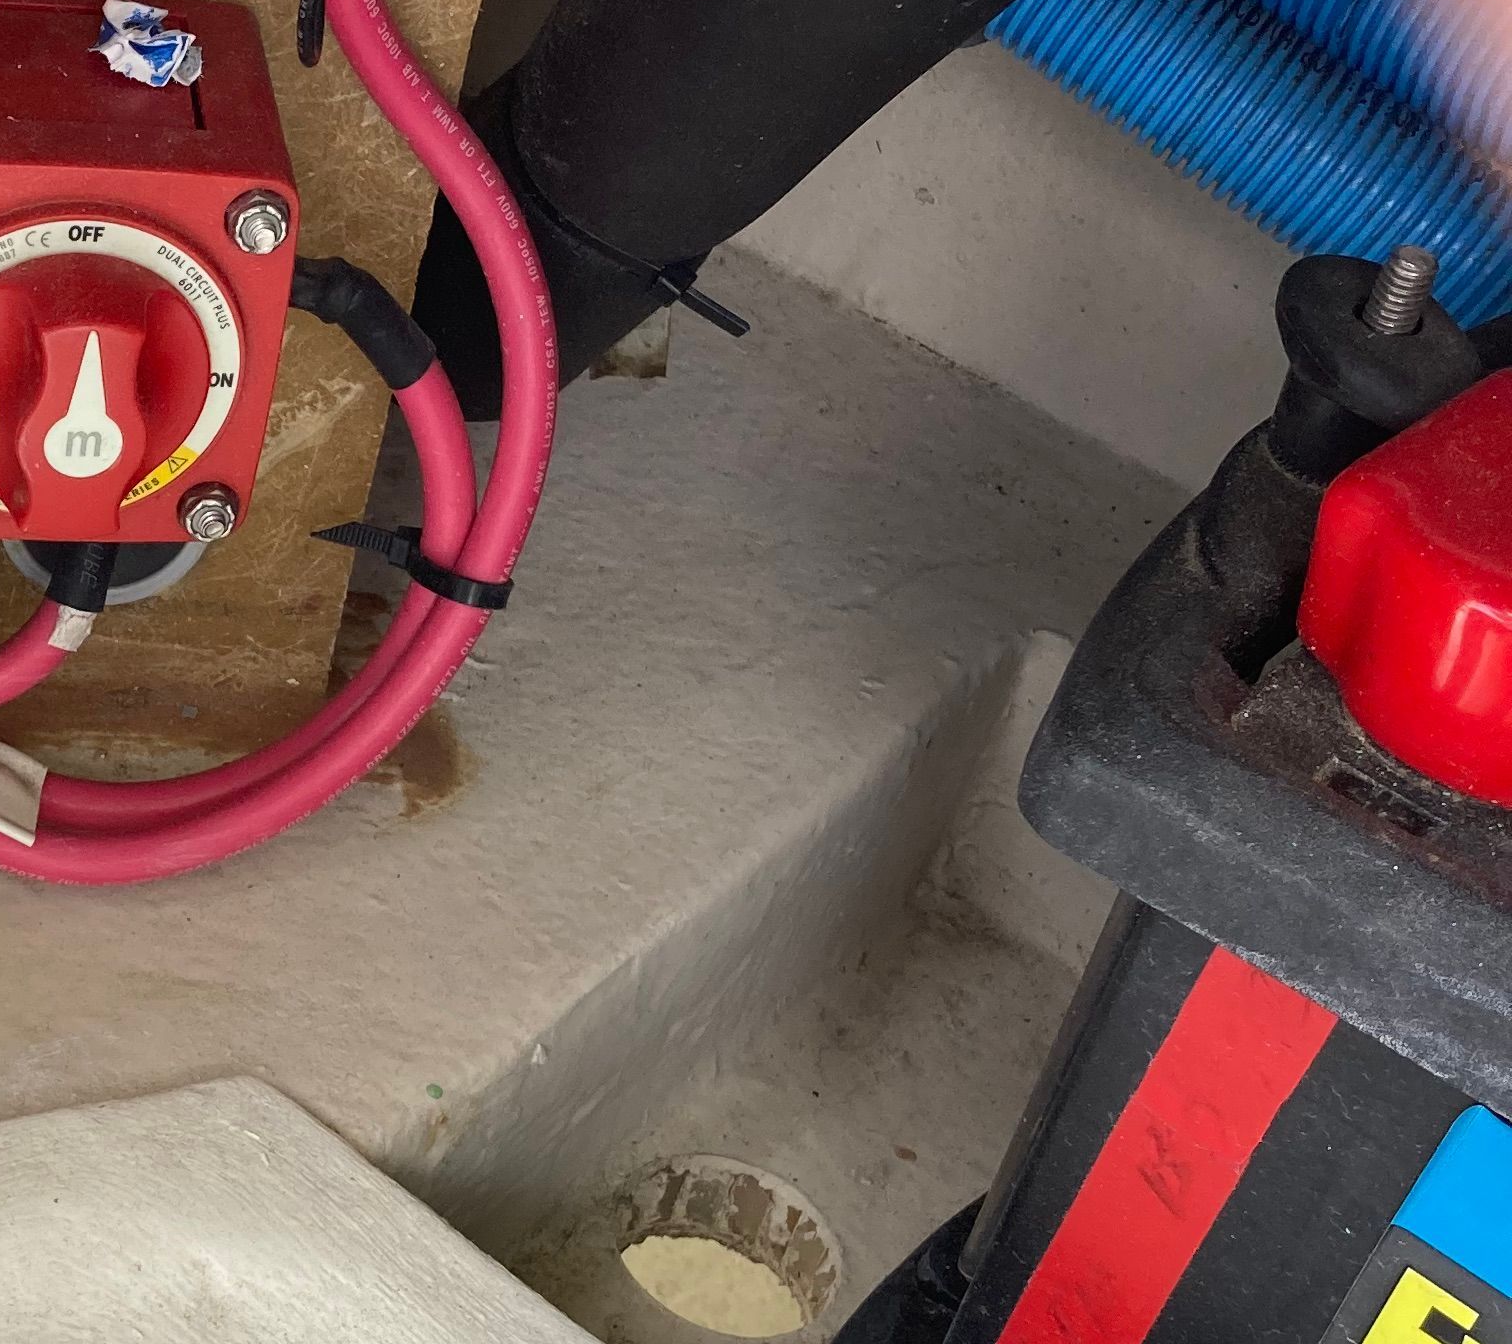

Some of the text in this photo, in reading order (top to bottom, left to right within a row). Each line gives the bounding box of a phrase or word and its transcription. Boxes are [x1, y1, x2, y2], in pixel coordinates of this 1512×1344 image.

[400, 62, 422, 88] A/B
[432, 103, 459, 135] AWM
[459, 137, 476, 158] OR
[476, 161, 497, 188] FT1
[495, 193, 520, 231] 600V
[25, 230, 52, 248] CE
[68, 225, 105, 243] OFF
[157, 245, 231, 330] DUAL CIRCUIT PLUS
[178, 277, 202, 302] 6011
[535, 294, 551, 327] TEW
[543, 337, 556, 370] CSA
[210, 373, 234, 388] ON
[65, 430, 102, 457] m
[460, 635, 478, 657] OIL
